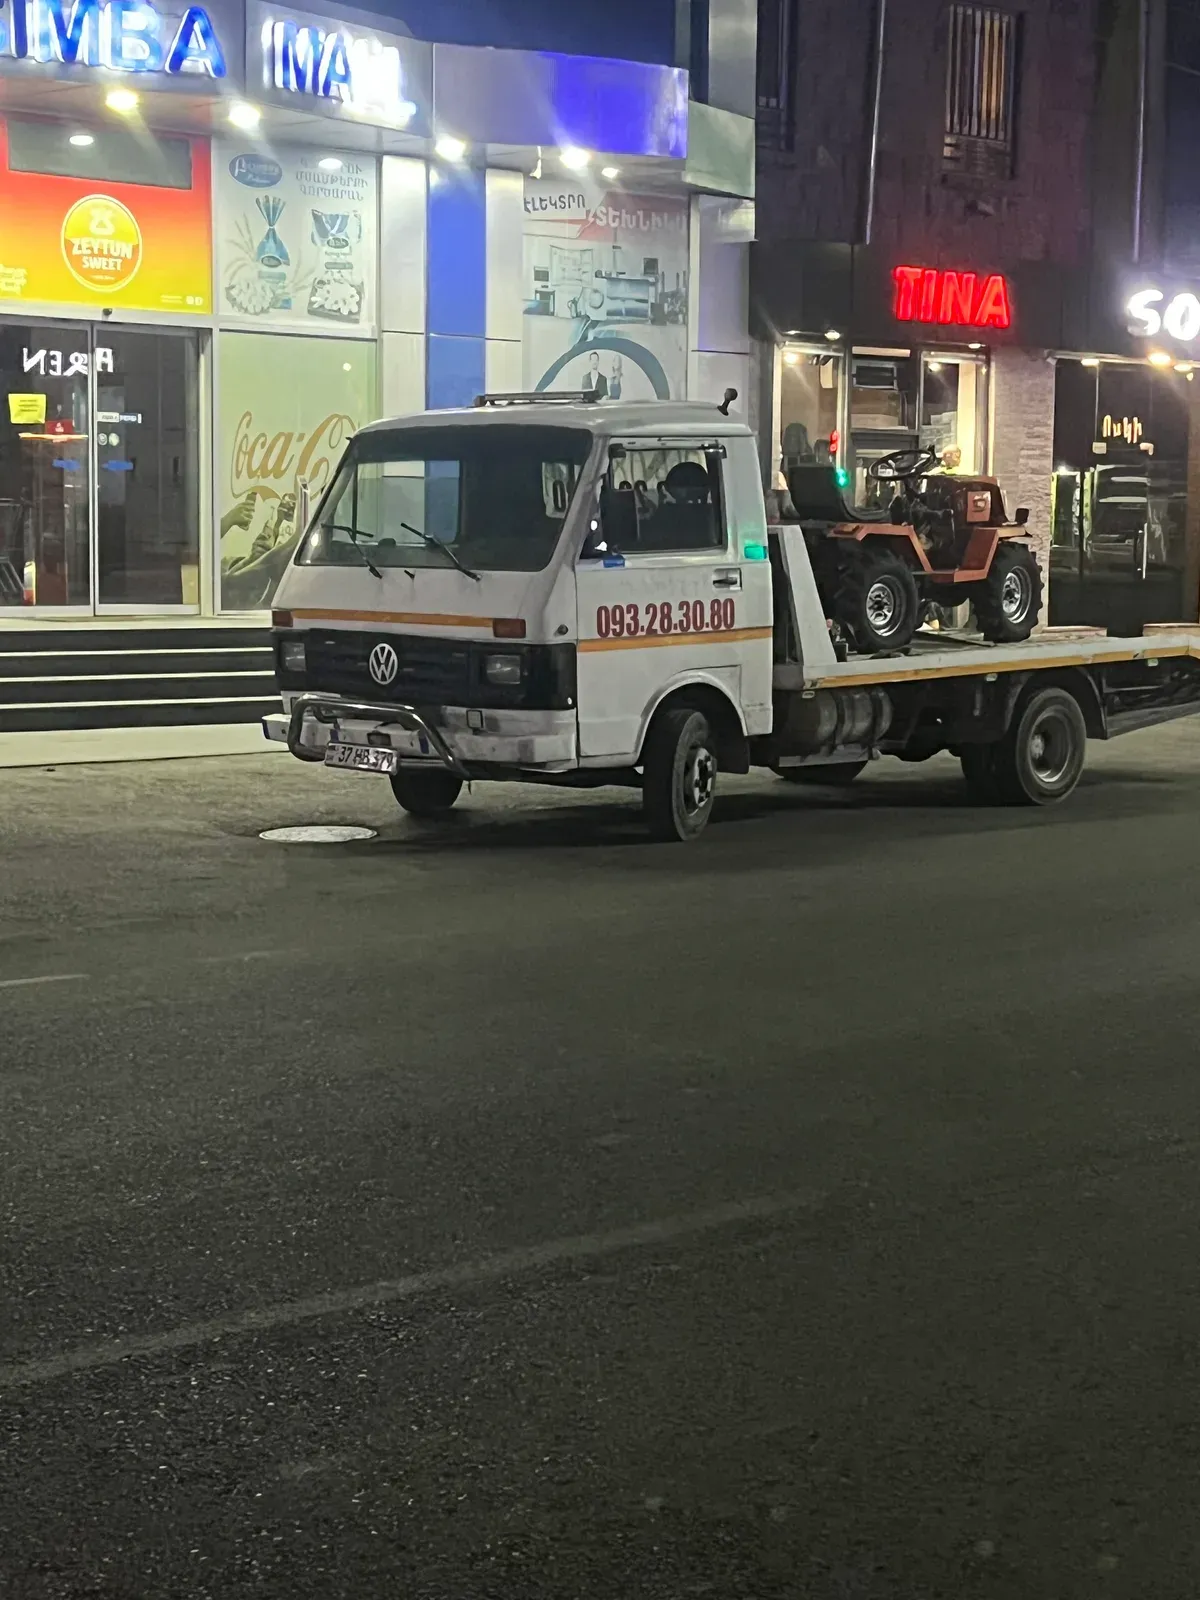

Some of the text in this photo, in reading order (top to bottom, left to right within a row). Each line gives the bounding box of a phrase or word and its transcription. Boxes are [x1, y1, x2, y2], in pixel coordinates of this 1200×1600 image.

[0, 0, 227, 78] IMBA
[72, 237, 134, 259] ZEYTUN
[82, 256, 123, 271] SWEET
[894, 265, 1011, 330] TINA
[1126, 289, 1200, 342] SO
[231, 410, 357, 501] Coca-C
[596, 598, 736, 638] 093.28.30.80
[338, 746, 354, 763] 37
